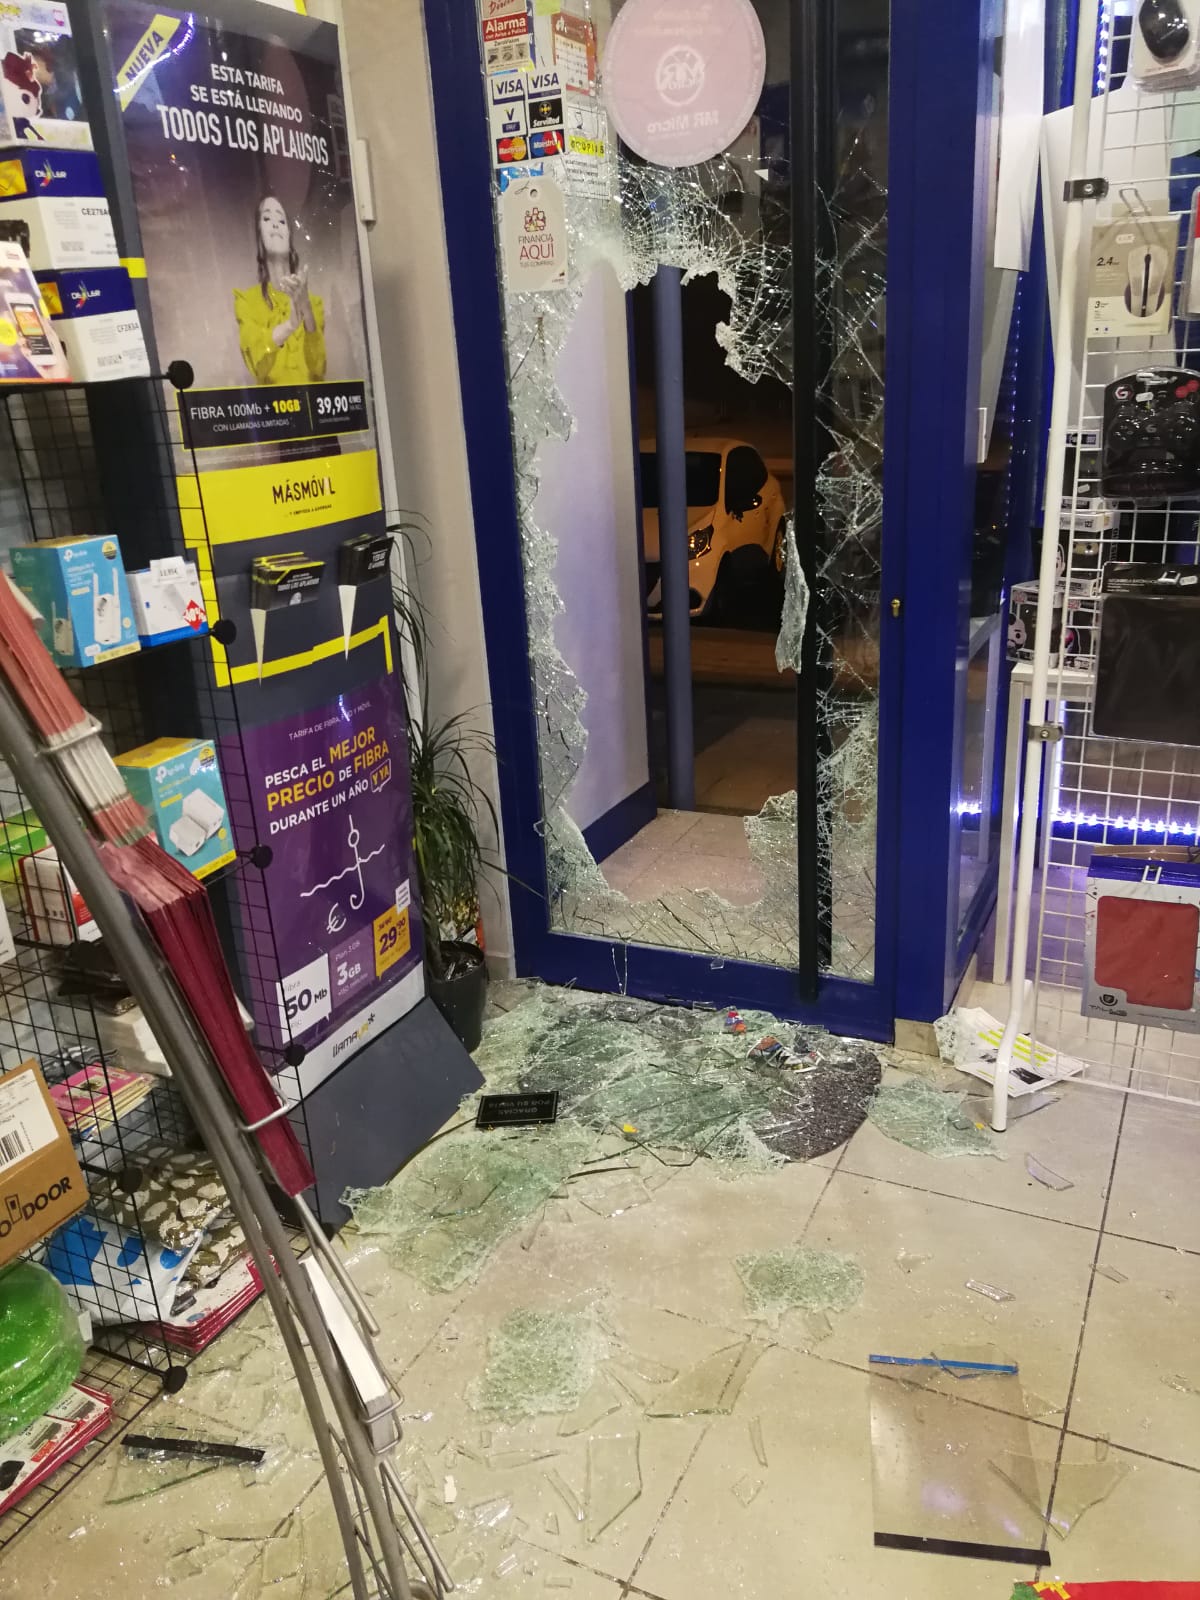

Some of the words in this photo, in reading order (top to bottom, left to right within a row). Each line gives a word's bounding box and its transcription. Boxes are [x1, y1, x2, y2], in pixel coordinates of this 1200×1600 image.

[486, 17, 526, 33] Alarma
[124, 30, 164, 82] NUEVA
[211, 64, 243, 85] ESTA
[245, 71, 284, 95] TARIFA
[496, 79, 524, 95] VISA
[531, 73, 559, 88] VISA
[190, 85, 208, 102] SE
[211, 87, 243, 110] ESTÁ
[246, 96, 303, 123] LLEVANDO
[157, 105, 221, 146] TODOS
[225, 116, 259, 152] LOS
[263, 123, 329, 166] APLAUSOS
[533, 139, 558, 149] Maestr
[518, 233, 554, 244] FINANCIA
[190, 405, 225, 420] FIBRA
[227, 402, 262, 417] 100Mb
[264, 404, 271, 413] +
[272, 399, 301, 414] 10GB
[316, 395, 349, 416] 39,90
[213, 424, 228, 432] CON
[229, 421, 260, 431] LLAMADAS
[261, 418, 290, 429] ILIMITADAS
[272, 475, 336, 504] MÁSMÓVL
[289, 727, 313, 741] TARIFA
[314, 722, 323, 732] DE
[265, 764, 309, 789] PESCA
[311, 756, 326, 772] EL
[329, 726, 376, 764] MEJOR
[266, 770, 335, 812] PRECIO
[338, 766, 352, 782] DE
[354, 740, 389, 774] FIBRA
[270, 800, 330, 835] DURANTE
[331, 791, 346, 808] UN
[349, 779, 369, 800] AÑO
[371, 773, 379, 786] Y
[379, 765, 390, 780] YA
[285, 989, 312, 1020] 50
[314, 988, 328, 1004] Mb
[22, 1176, 72, 1221] DOOR
